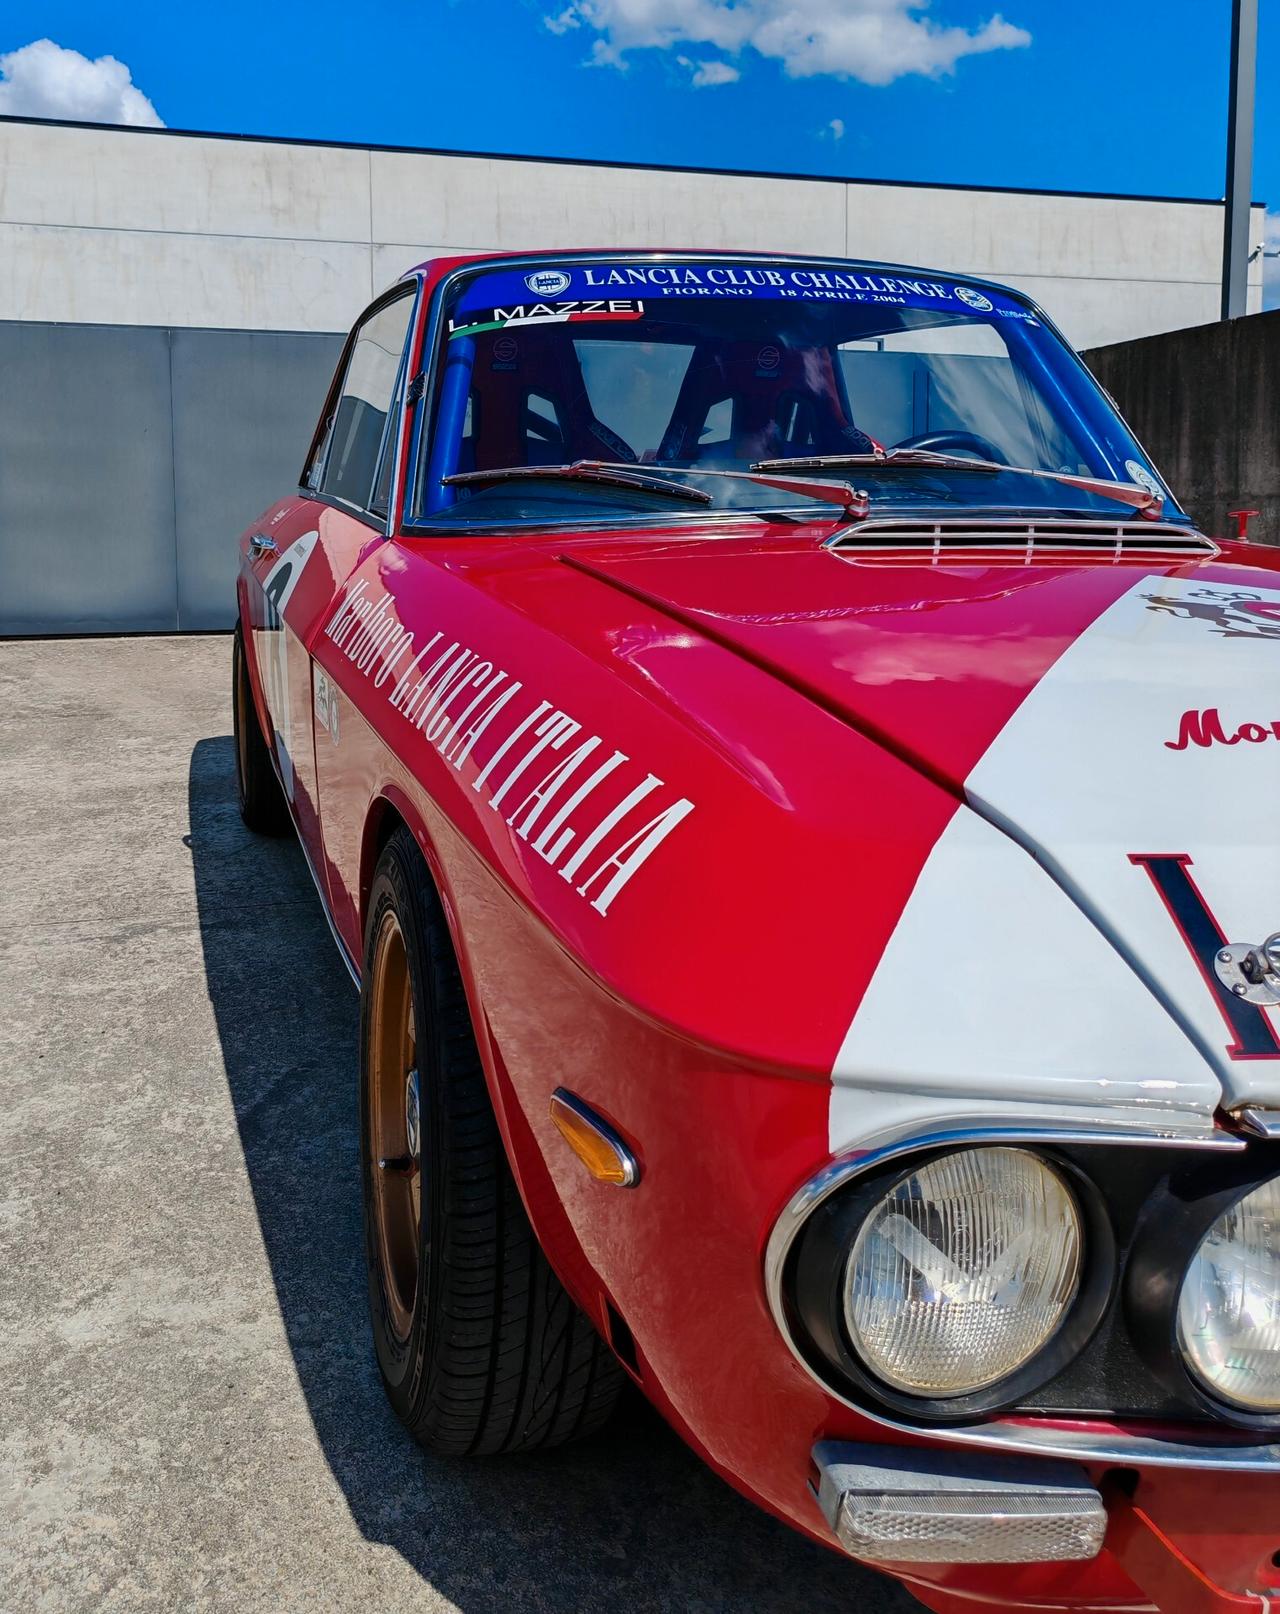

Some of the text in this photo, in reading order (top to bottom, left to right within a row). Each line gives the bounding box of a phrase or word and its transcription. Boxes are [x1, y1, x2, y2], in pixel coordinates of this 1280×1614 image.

[584, 268, 703, 286] LANCIA
[706, 269, 786, 287] CLUB
[790, 272, 953, 300] CHALLENGE
[662, 287, 906, 304] FIORANO 18 APRILE 2004
[448, 300, 644, 333] L. MAZZEI
[323, 578, 414, 689] Marlboro
[388, 631, 523, 772] LANCIA
[471, 699, 696, 918] ITALIA
